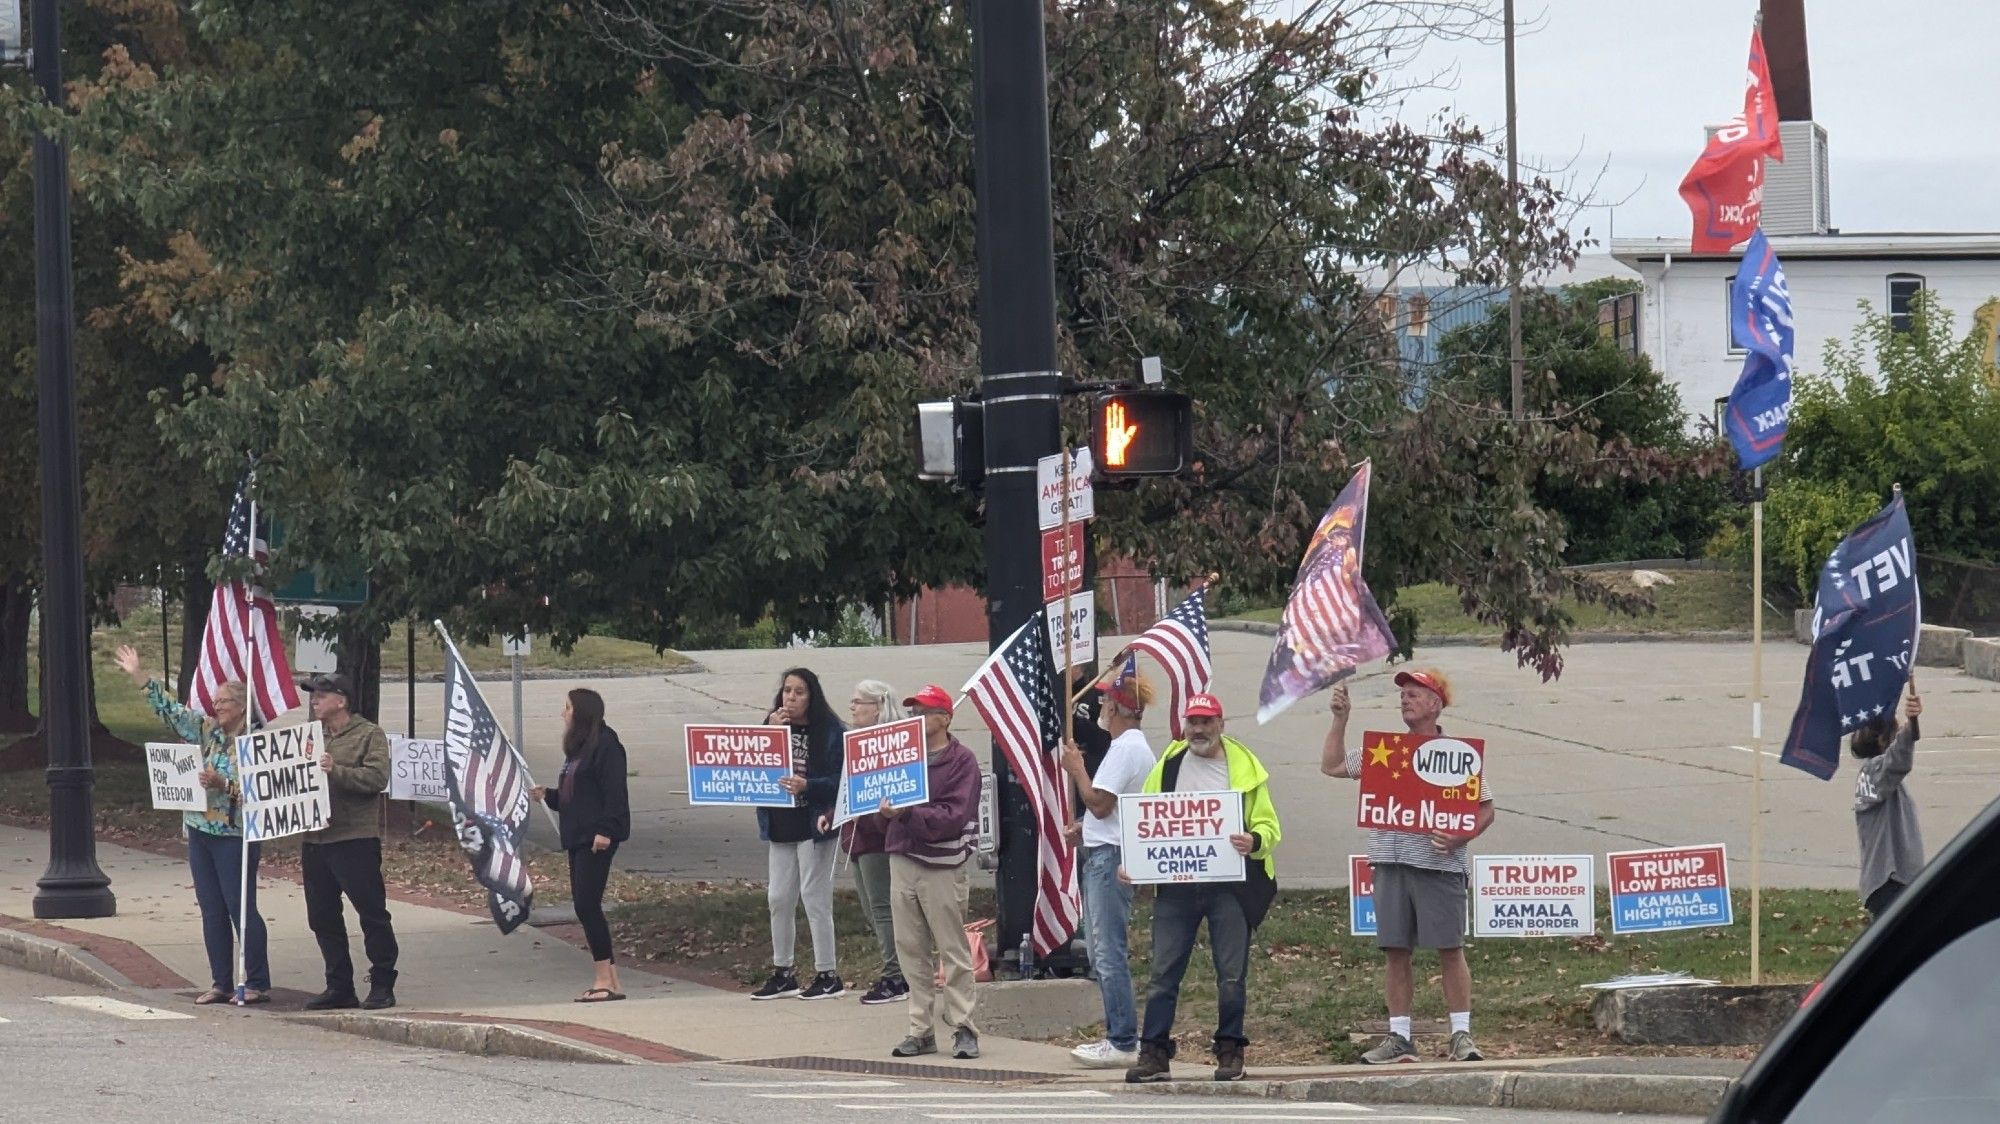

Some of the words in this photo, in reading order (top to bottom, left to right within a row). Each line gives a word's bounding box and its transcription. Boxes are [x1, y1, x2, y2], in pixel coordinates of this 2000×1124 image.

[1054, 460, 1078, 478] KEP
[1042, 476, 1090, 499] AMEICA
[1055, 534, 1074, 553] TET
[1047, 574, 1060, 589] TO
[1050, 606, 1088, 634] TRMP
[1055, 625, 1081, 647] 204
[238, 727, 303, 767] KRAZY
[704, 735, 771, 752] TRUMP
[858, 731, 910, 757] TRUMP
[175, 755, 196, 775] WAVE
[695, 752, 730, 765] LOW
[734, 752, 782, 766] TAXES
[852, 757, 878, 773] LOW
[881, 747, 918, 766] TAXES
[1416, 749, 1475, 776] WMUR
[153, 768, 168, 785] FOR
[242, 761, 319, 803] KOMMIE
[711, 769, 769, 782] KAMALA
[864, 769, 908, 787] KAMALA
[157, 786, 194, 802] FREEDOM
[702, 781, 734, 793] HIGH
[737, 783, 780, 795] TAXES
[856, 787, 882, 803] HIGH
[885, 779, 917, 798] TAXES
[1442, 786, 1460, 800] ch
[1466, 775, 1480, 801] 9
[1138, 799, 1221, 819] TRUMP
[1360, 793, 1415, 827] Fake
[1419, 799, 1475, 831] News
[245, 799, 321, 840] KAMALA
[1137, 818, 1224, 838] SAFETY
[1147, 845, 1217, 860] KAMALA
[1157, 859, 1208, 874] CRIME
[1489, 865, 1577, 884] TRUMP
[1629, 857, 1704, 878] TRUMP
[1481, 886, 1530, 896] SECURE
[1534, 886, 1585, 896] BORDER
[1620, 879, 1656, 893] LOW
[1661, 874, 1717, 890] PRICES
[1638, 893, 1702, 908] KAMALA
[1494, 904, 1573, 917] KAMALA
[1624, 908, 1660, 921] HIGH
[1665, 903, 1718, 918] PRICES
[1489, 918, 1524, 929] OPEN
[1527, 918, 1579, 929] BORDER
